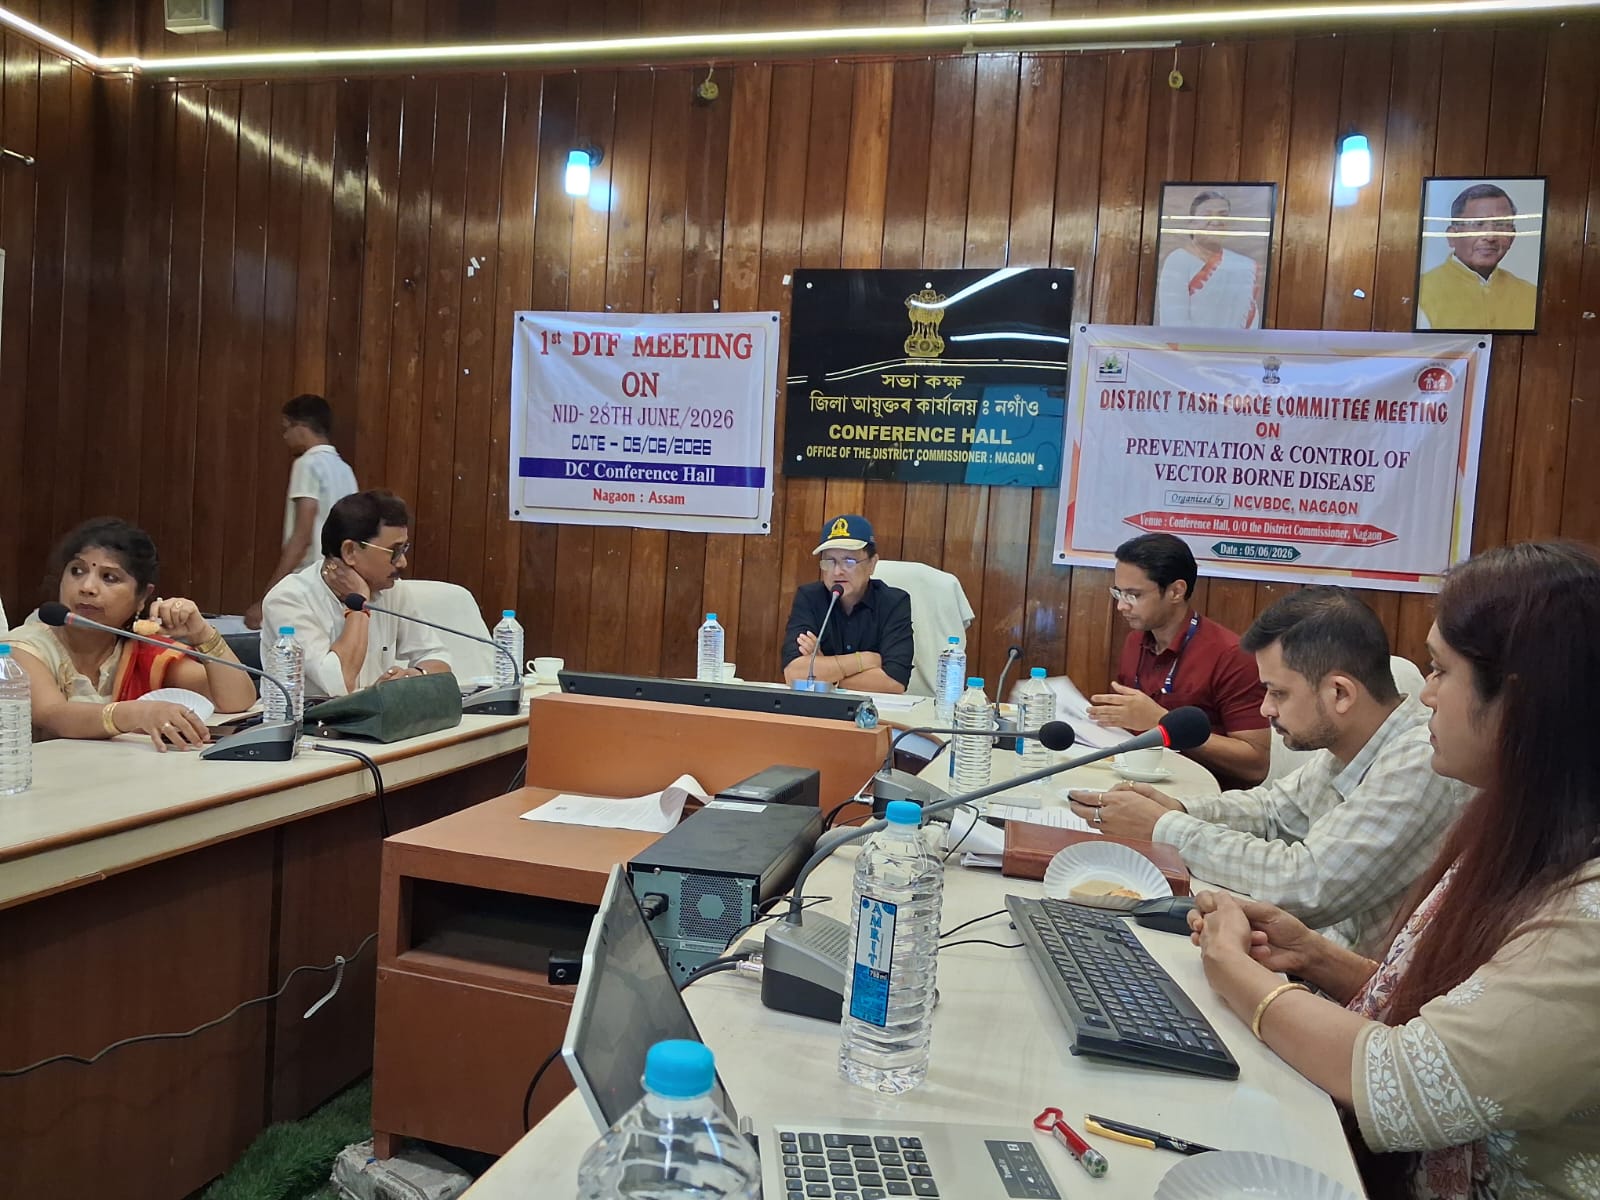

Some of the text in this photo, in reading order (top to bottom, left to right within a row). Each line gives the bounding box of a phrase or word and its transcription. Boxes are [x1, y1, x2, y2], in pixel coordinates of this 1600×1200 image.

[540, 330, 753, 360] 1st DTF MEETING
[621, 371, 660, 398] ON
[881, 372, 965, 390] সভা কক্ষ
[809, 389, 849, 413] জিলা
[1100, 388, 1448, 425] DISTRICT TASK FORCE COMMITTEE MEETING
[552, 403, 734, 429] NID- 28TH JUNE/2026
[828, 424, 1013, 445] CONFERENCE HALL
[1255, 421, 1281, 438] ON
[571, 434, 606, 451] DATE
[622, 434, 712, 457] 05/06/2026
[806, 445, 838, 458] OFFICE
[839, 446, 851, 458] OF
[853, 447, 872, 459] THE
[873, 447, 915, 461] DISTRICT
[916, 448, 987, 464] COMMISSIONER
[994, 450, 1035, 465] NAGAON
[1126, 437, 1412, 469] PREVENTATION & CONTROL OF
[564, 461, 716, 483] DC Conference Hall
[1154, 463, 1376, 493] VECTOR BORNE DISEASE
[593, 488, 636, 505] Nagaon
[648, 491, 686, 505] Assam
[1171, 493, 1359, 515] Organized by NCVBDC, NAGAON
[1140, 514, 1163, 527] Venue
[1168, 516, 1211, 531] Conference
[1213, 518, 1230, 532] Hall,
[1249, 521, 1262, 533] the
[1263, 521, 1293, 536] District
[1294, 524, 1351, 540] Commissioner,
[1352, 527, 1383, 543] Nagaon
[1220, 544, 1238, 556] Date
[1244, 545, 1294, 560] 05/06/2026
[868, 902, 882, 968] AMRIT
